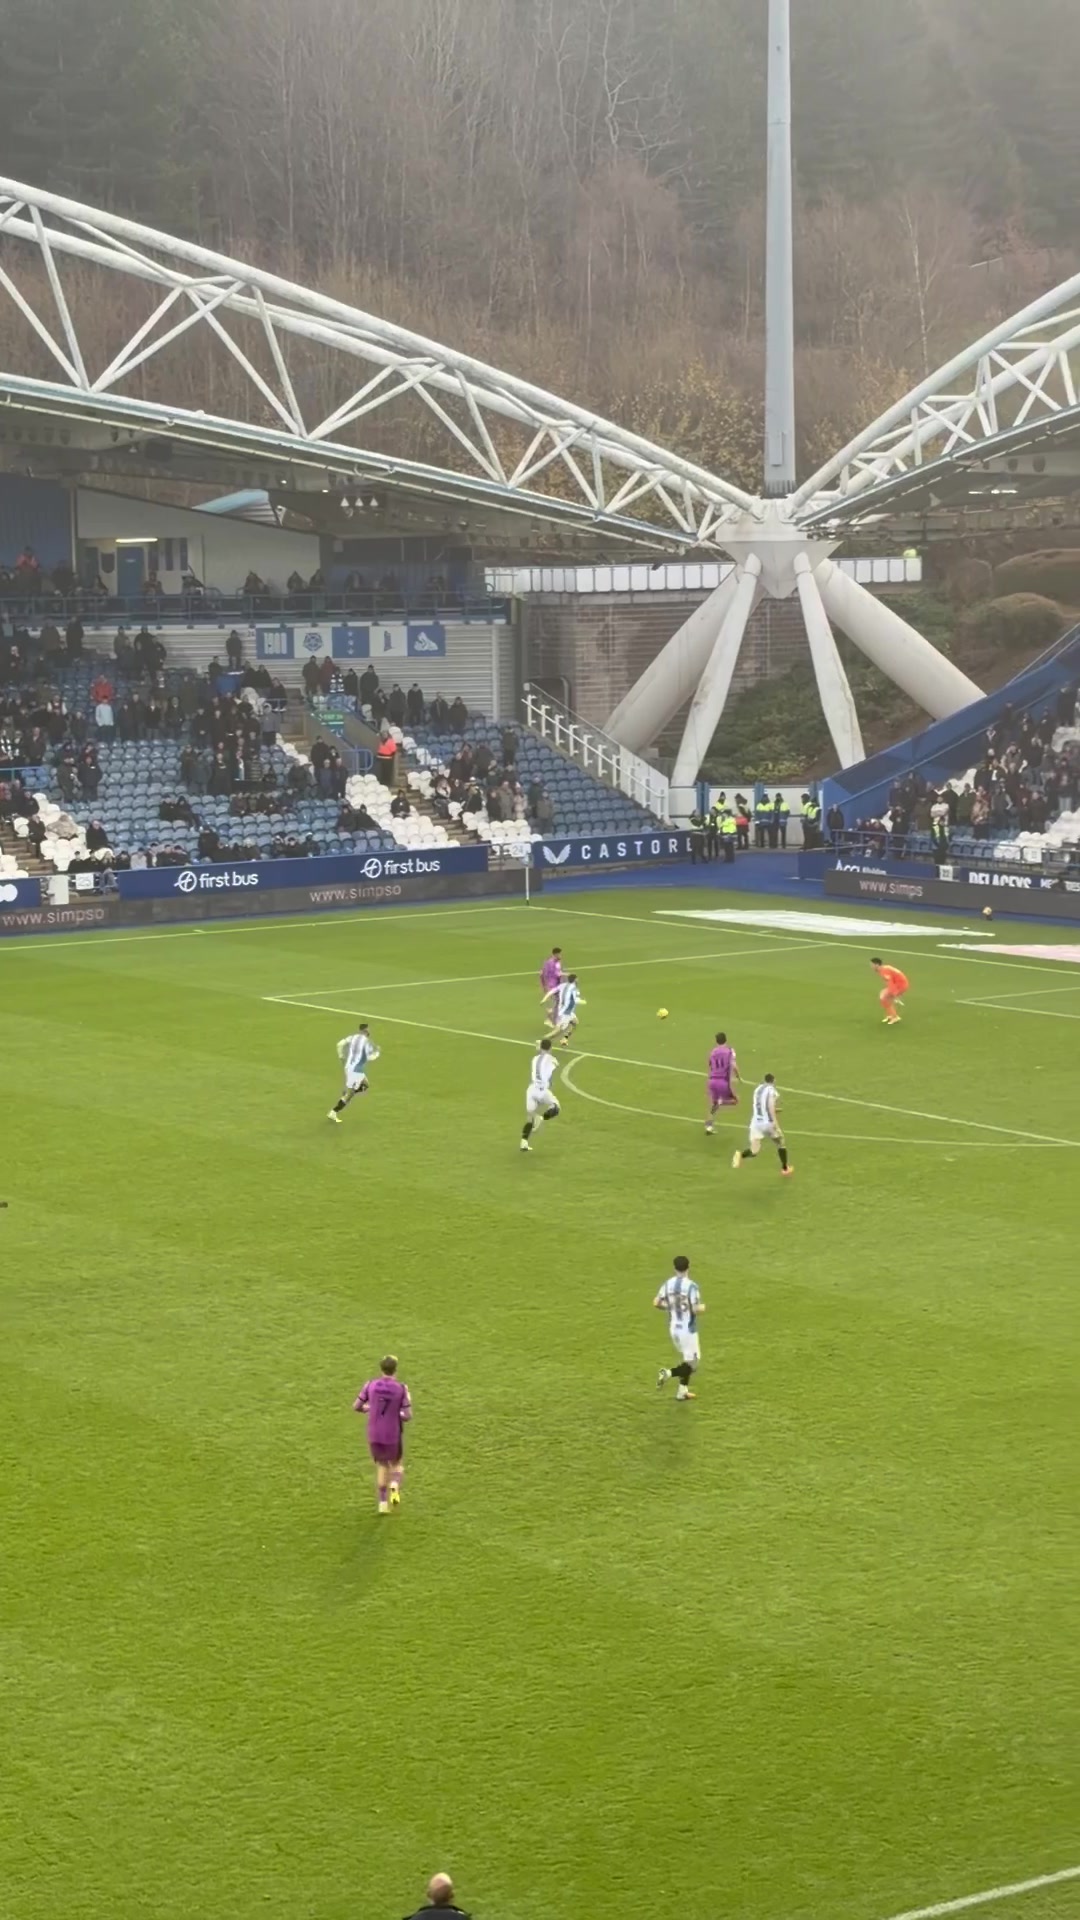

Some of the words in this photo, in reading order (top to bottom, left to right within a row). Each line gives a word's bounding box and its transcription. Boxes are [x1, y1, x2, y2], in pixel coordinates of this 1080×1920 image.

[384, 858, 413, 874] first
[415, 857, 441, 872] bus
[198, 871, 230, 888] first
[231, 871, 259, 886] bus
[379, 1396, 392, 1417] 7
